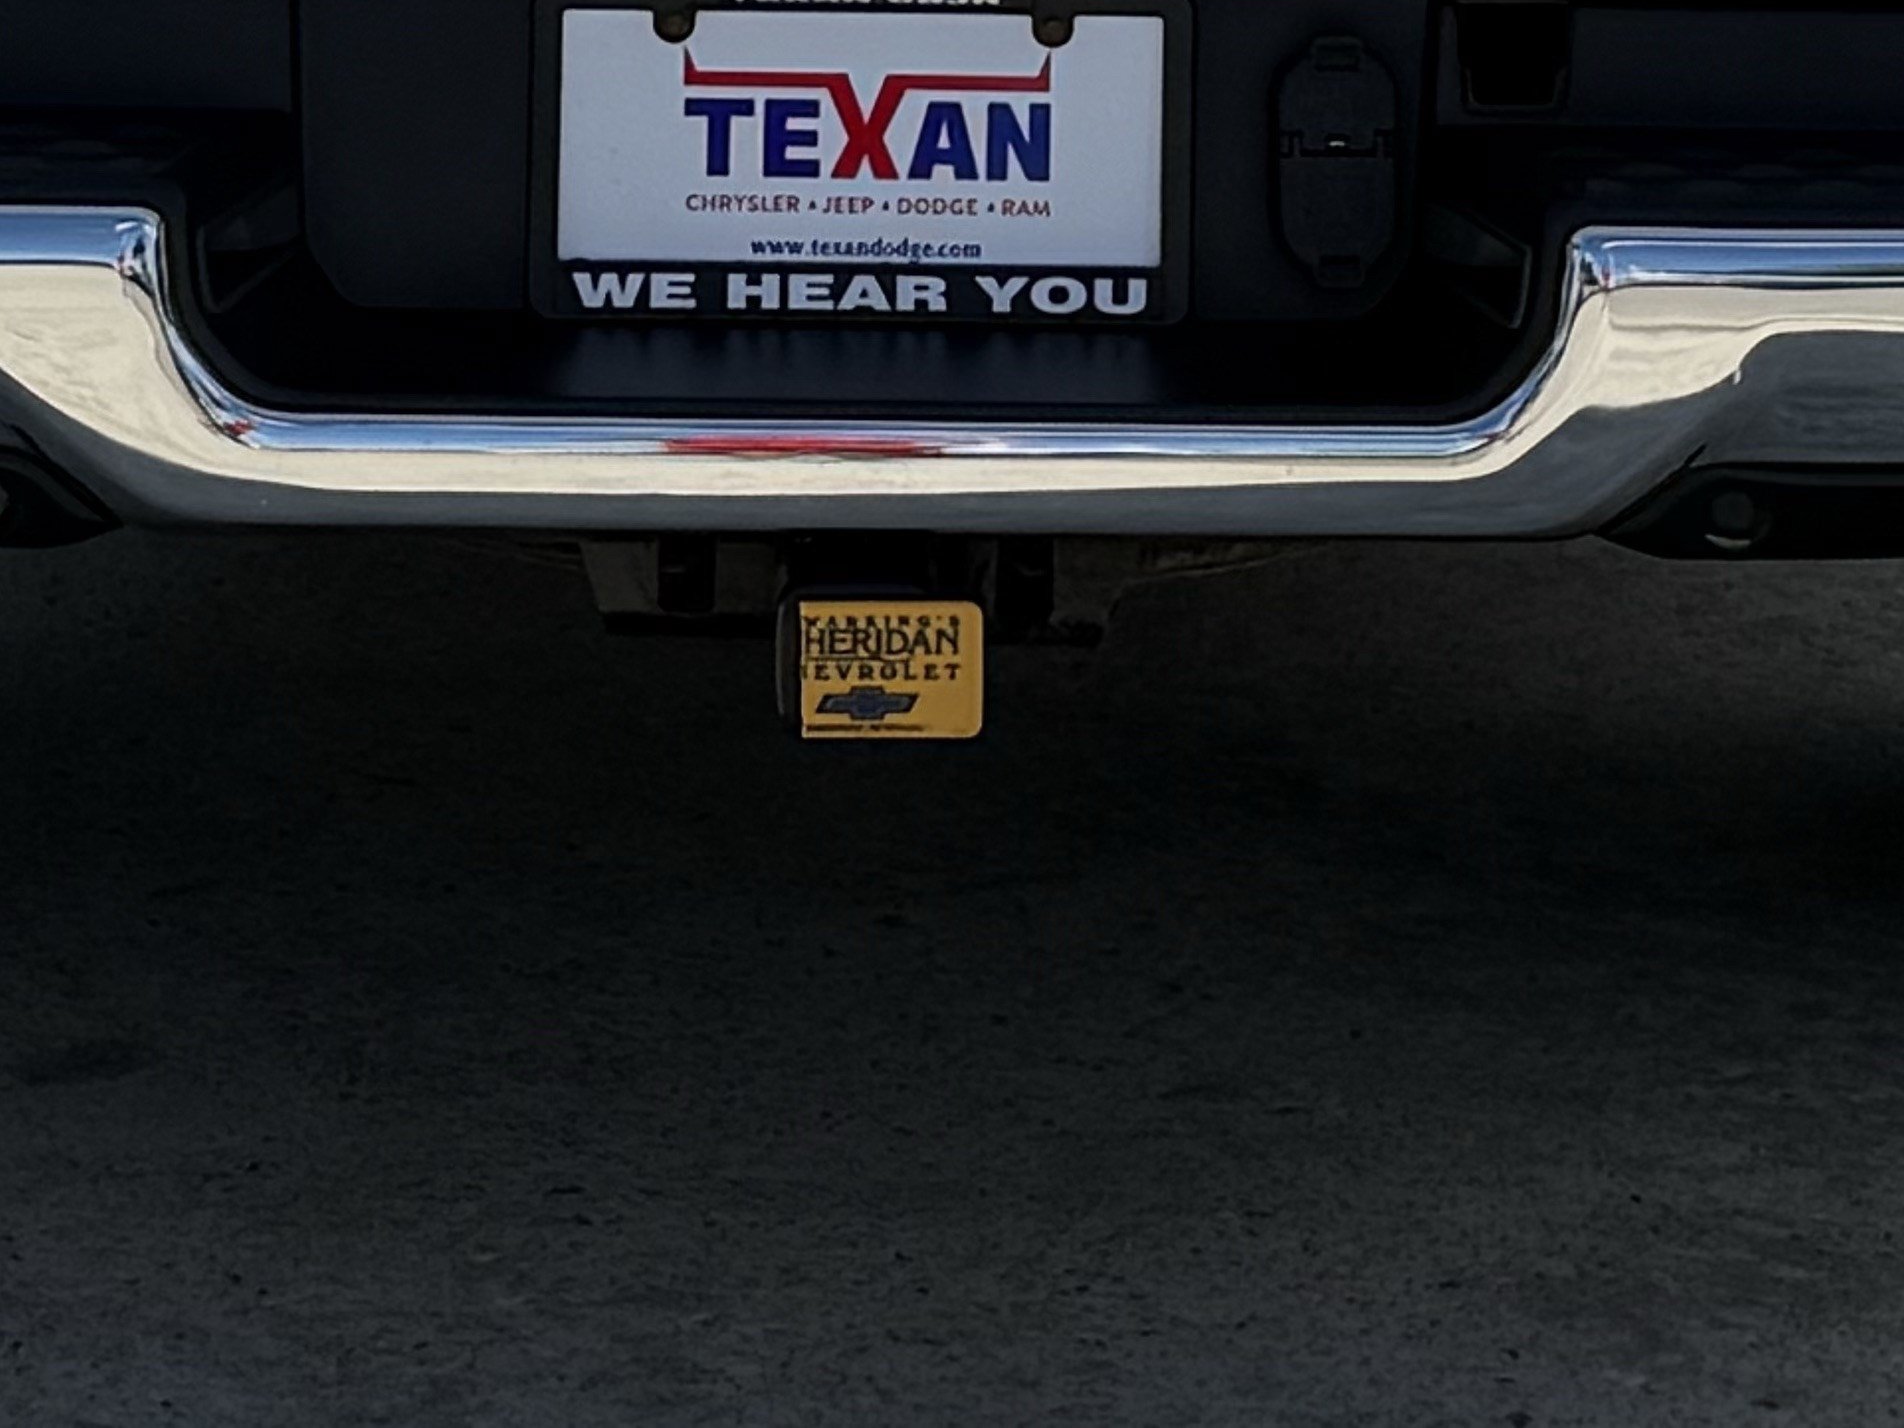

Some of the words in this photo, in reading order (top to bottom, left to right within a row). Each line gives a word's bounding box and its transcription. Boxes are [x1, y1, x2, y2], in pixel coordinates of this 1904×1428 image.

[684, 70, 1052, 182] TEXAN
[685, 193, 801, 214] CHRYSLER
[821, 196, 875, 215] JEEP
[896, 197, 979, 217] DODGE
[1000, 199, 1051, 218] RAM
[750, 238, 982, 264] www.texandodge.com
[573, 272, 696, 310] WE
[727, 274, 948, 312] HEAR
[977, 276, 1149, 315] YOU
[802, 627, 960, 657] HERIDAN
[801, 662, 962, 681] EVROLET
